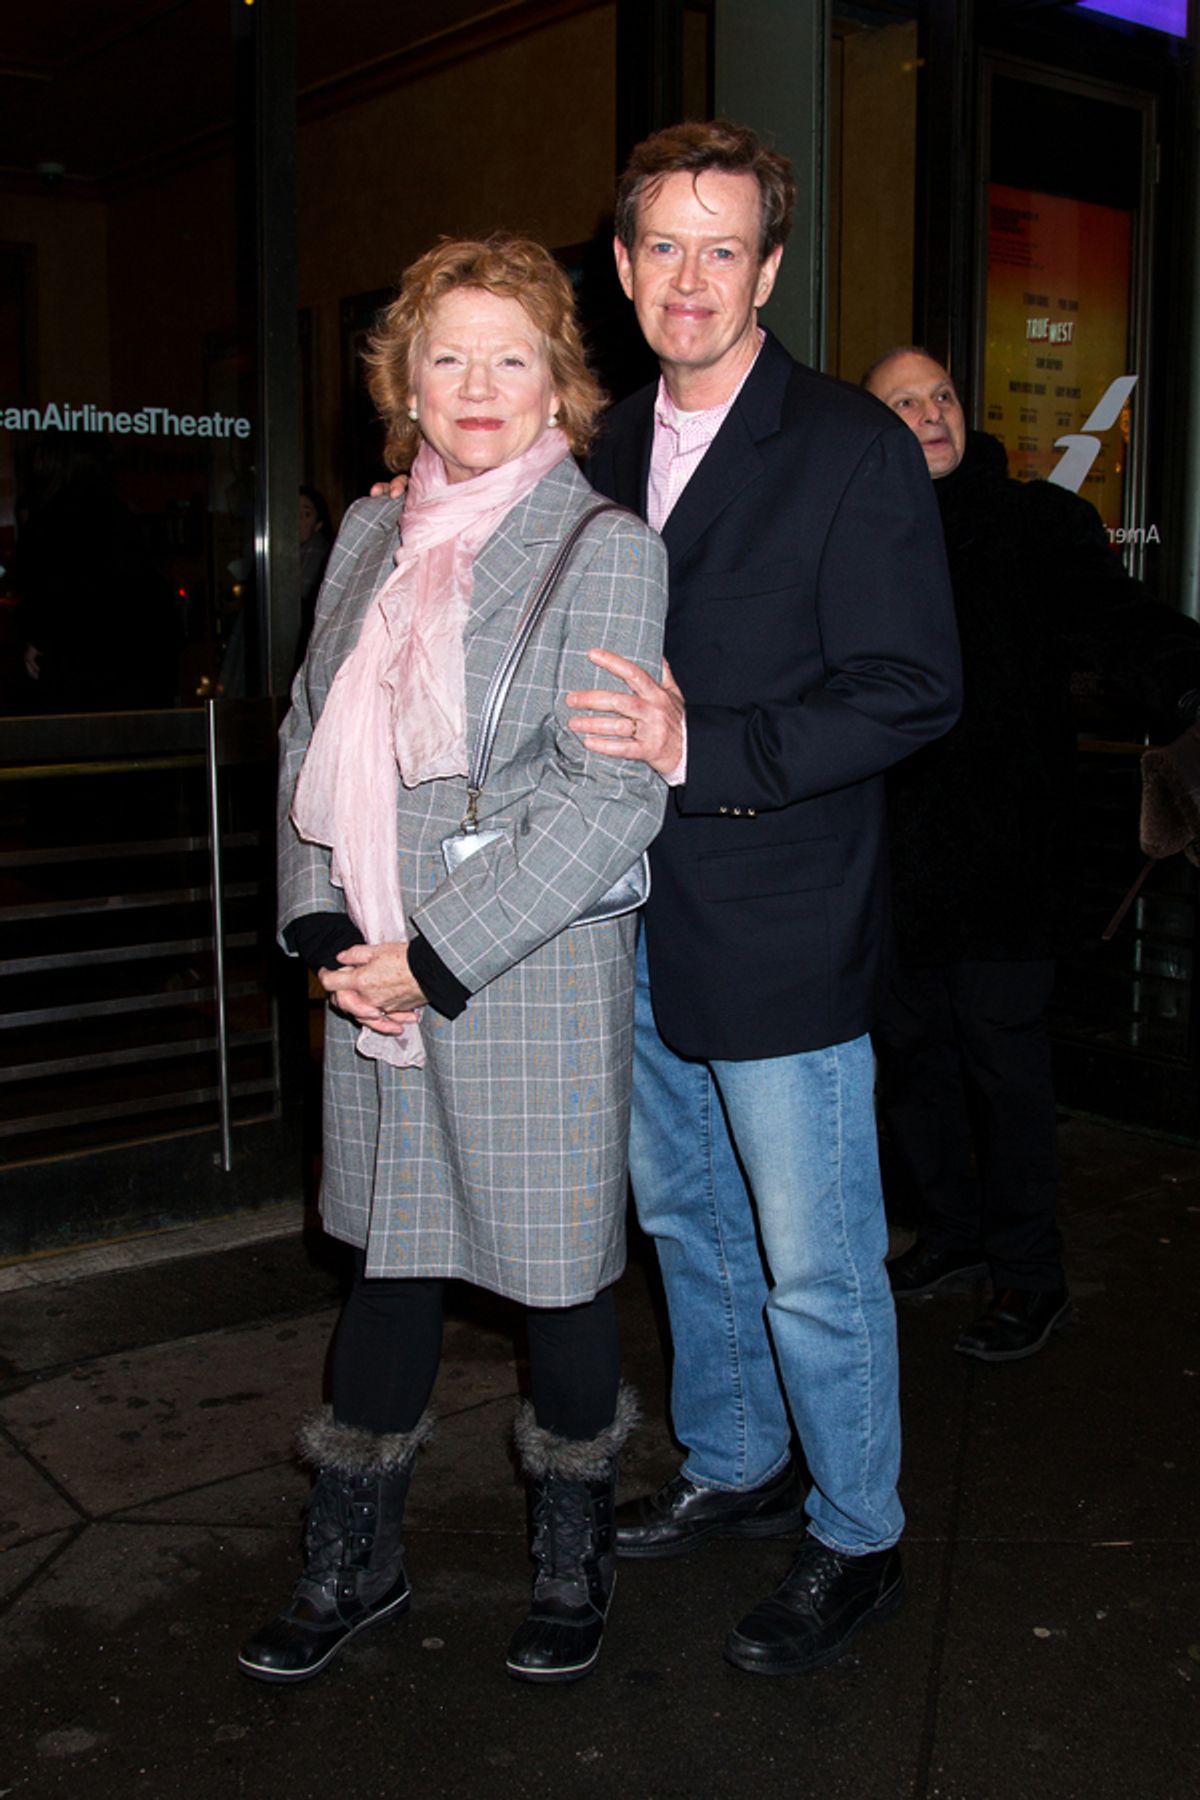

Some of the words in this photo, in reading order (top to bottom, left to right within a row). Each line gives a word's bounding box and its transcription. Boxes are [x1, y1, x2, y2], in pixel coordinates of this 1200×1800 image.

[1026, 317, 1050, 339] TRUE
[1050, 321, 1073, 342] WEST
[0, 403, 250, 438] anAirlinesTheatre
